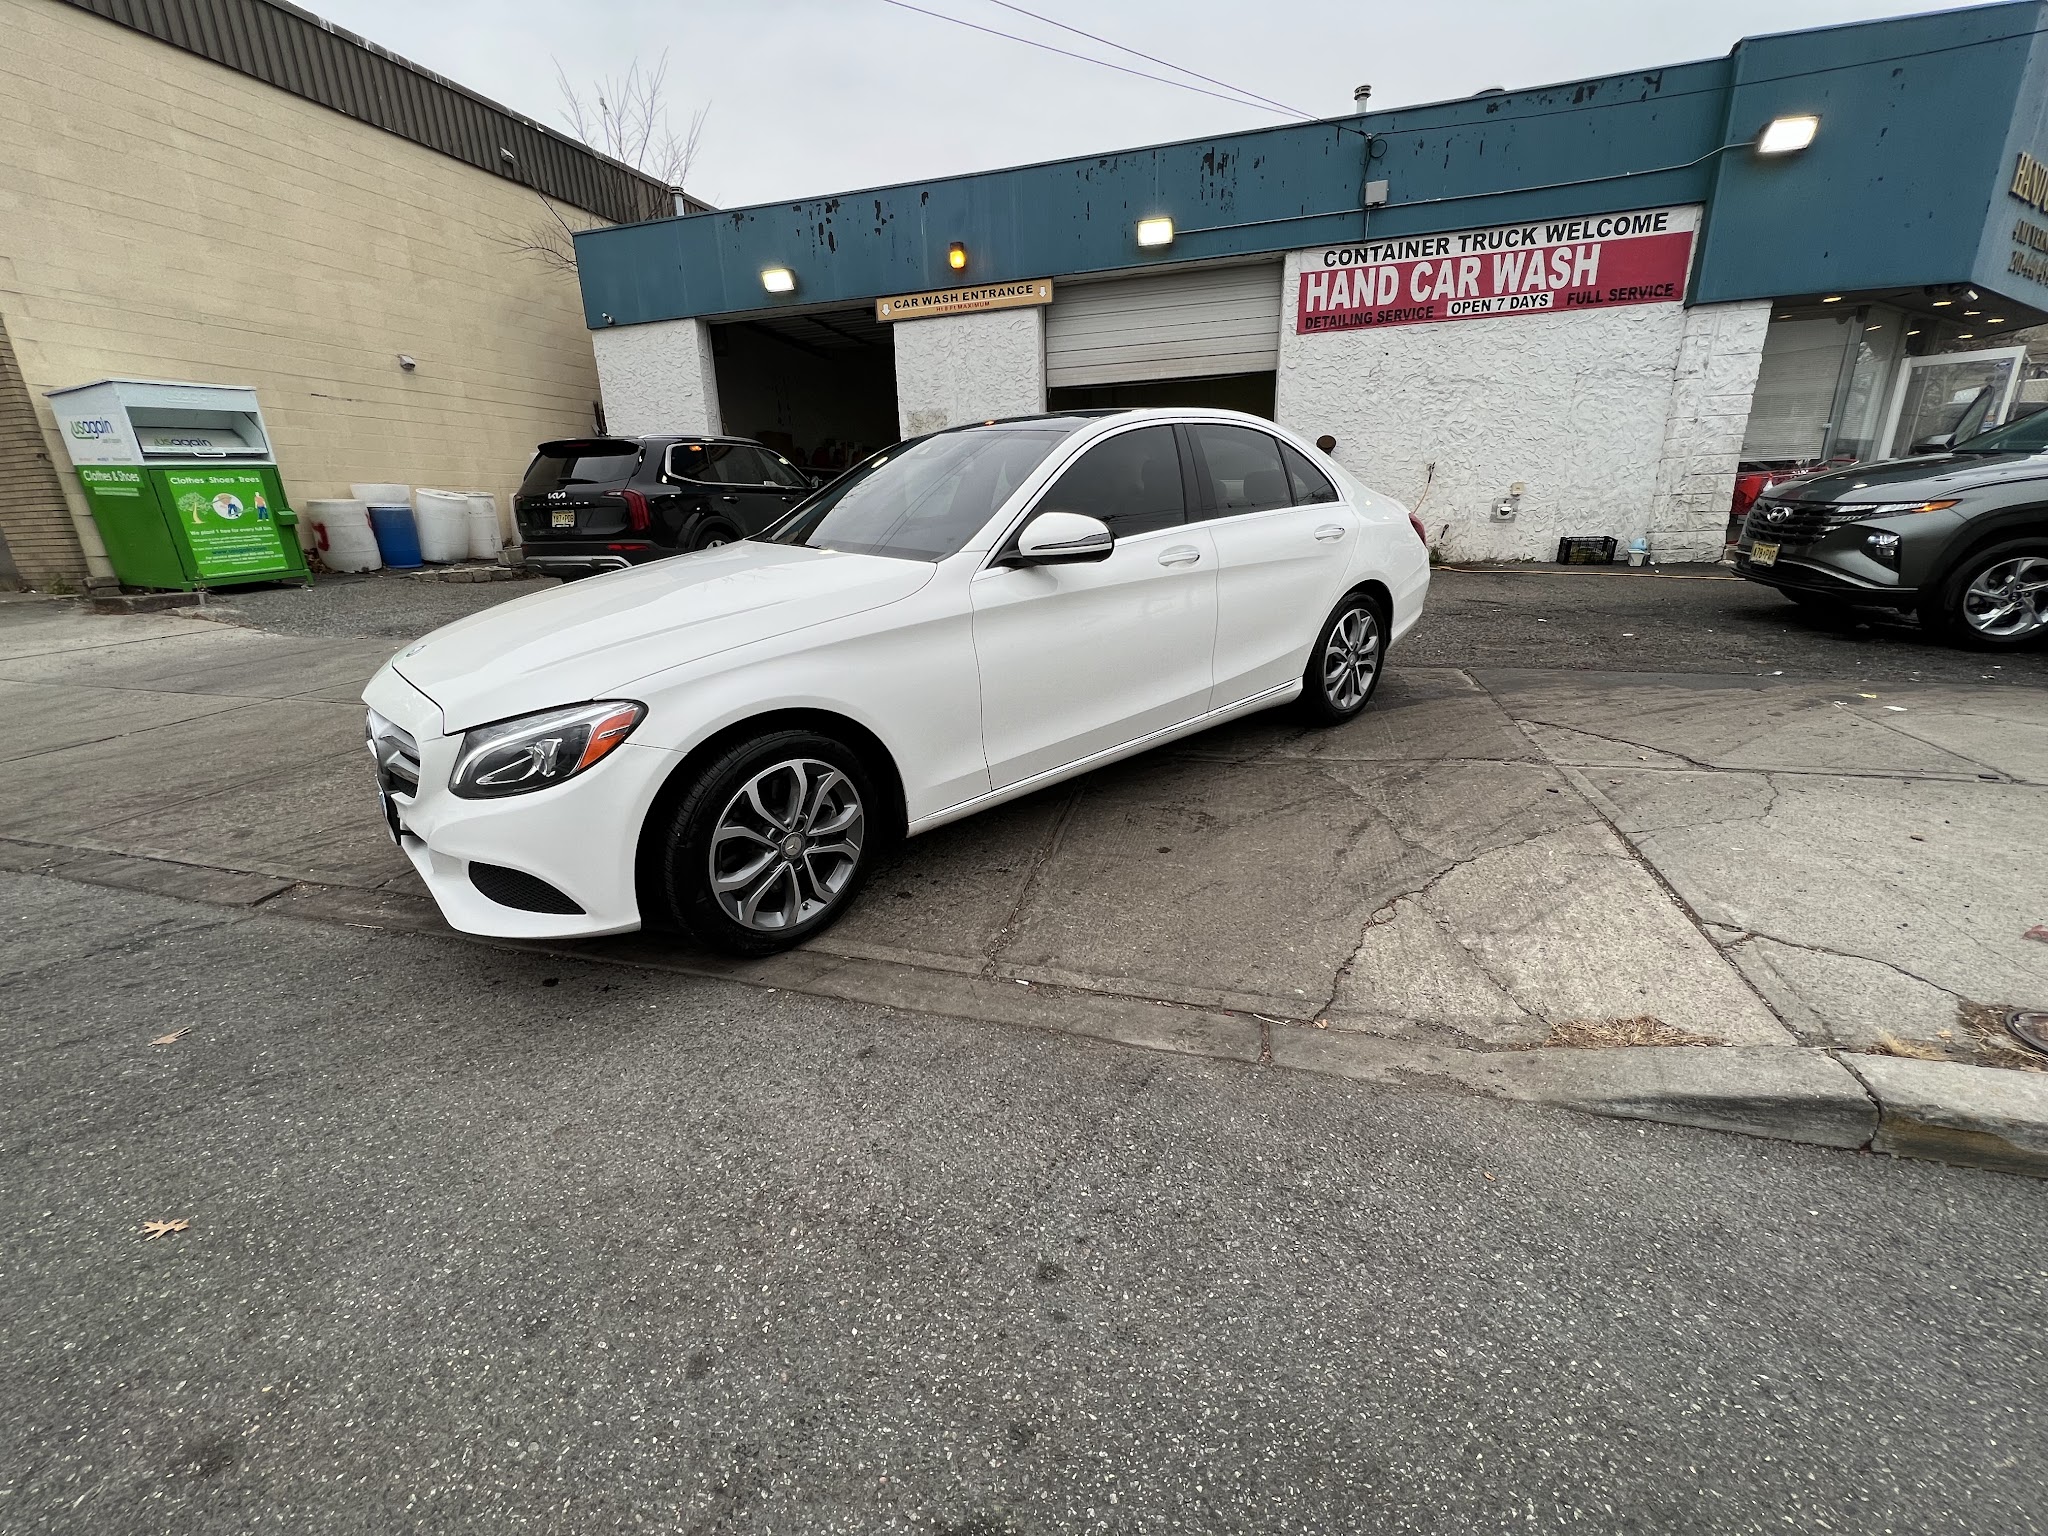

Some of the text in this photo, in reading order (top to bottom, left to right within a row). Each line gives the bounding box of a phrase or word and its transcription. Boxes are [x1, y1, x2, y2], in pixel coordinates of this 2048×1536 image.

[1323, 212, 1669, 267] CONTAINER TRUCK WELCOME
[1305, 243, 1601, 313] HAND CAR WASH
[893, 284, 1034, 309] CAR WASH ENTRANCE
[1451, 293, 1549, 315] OPEN 7 DAYS
[1567, 283, 1675, 306] FULL SERVICE
[1305, 306, 1434, 330] DETAILING SERVICE
[70, 416, 114, 439] usagain
[154, 438, 213, 447] usagain
[83, 470, 112, 481] Clothes
[117, 470, 140, 482] Shoes
[170, 477, 205, 485] Clothes
[209, 476, 235, 484] Shoes
